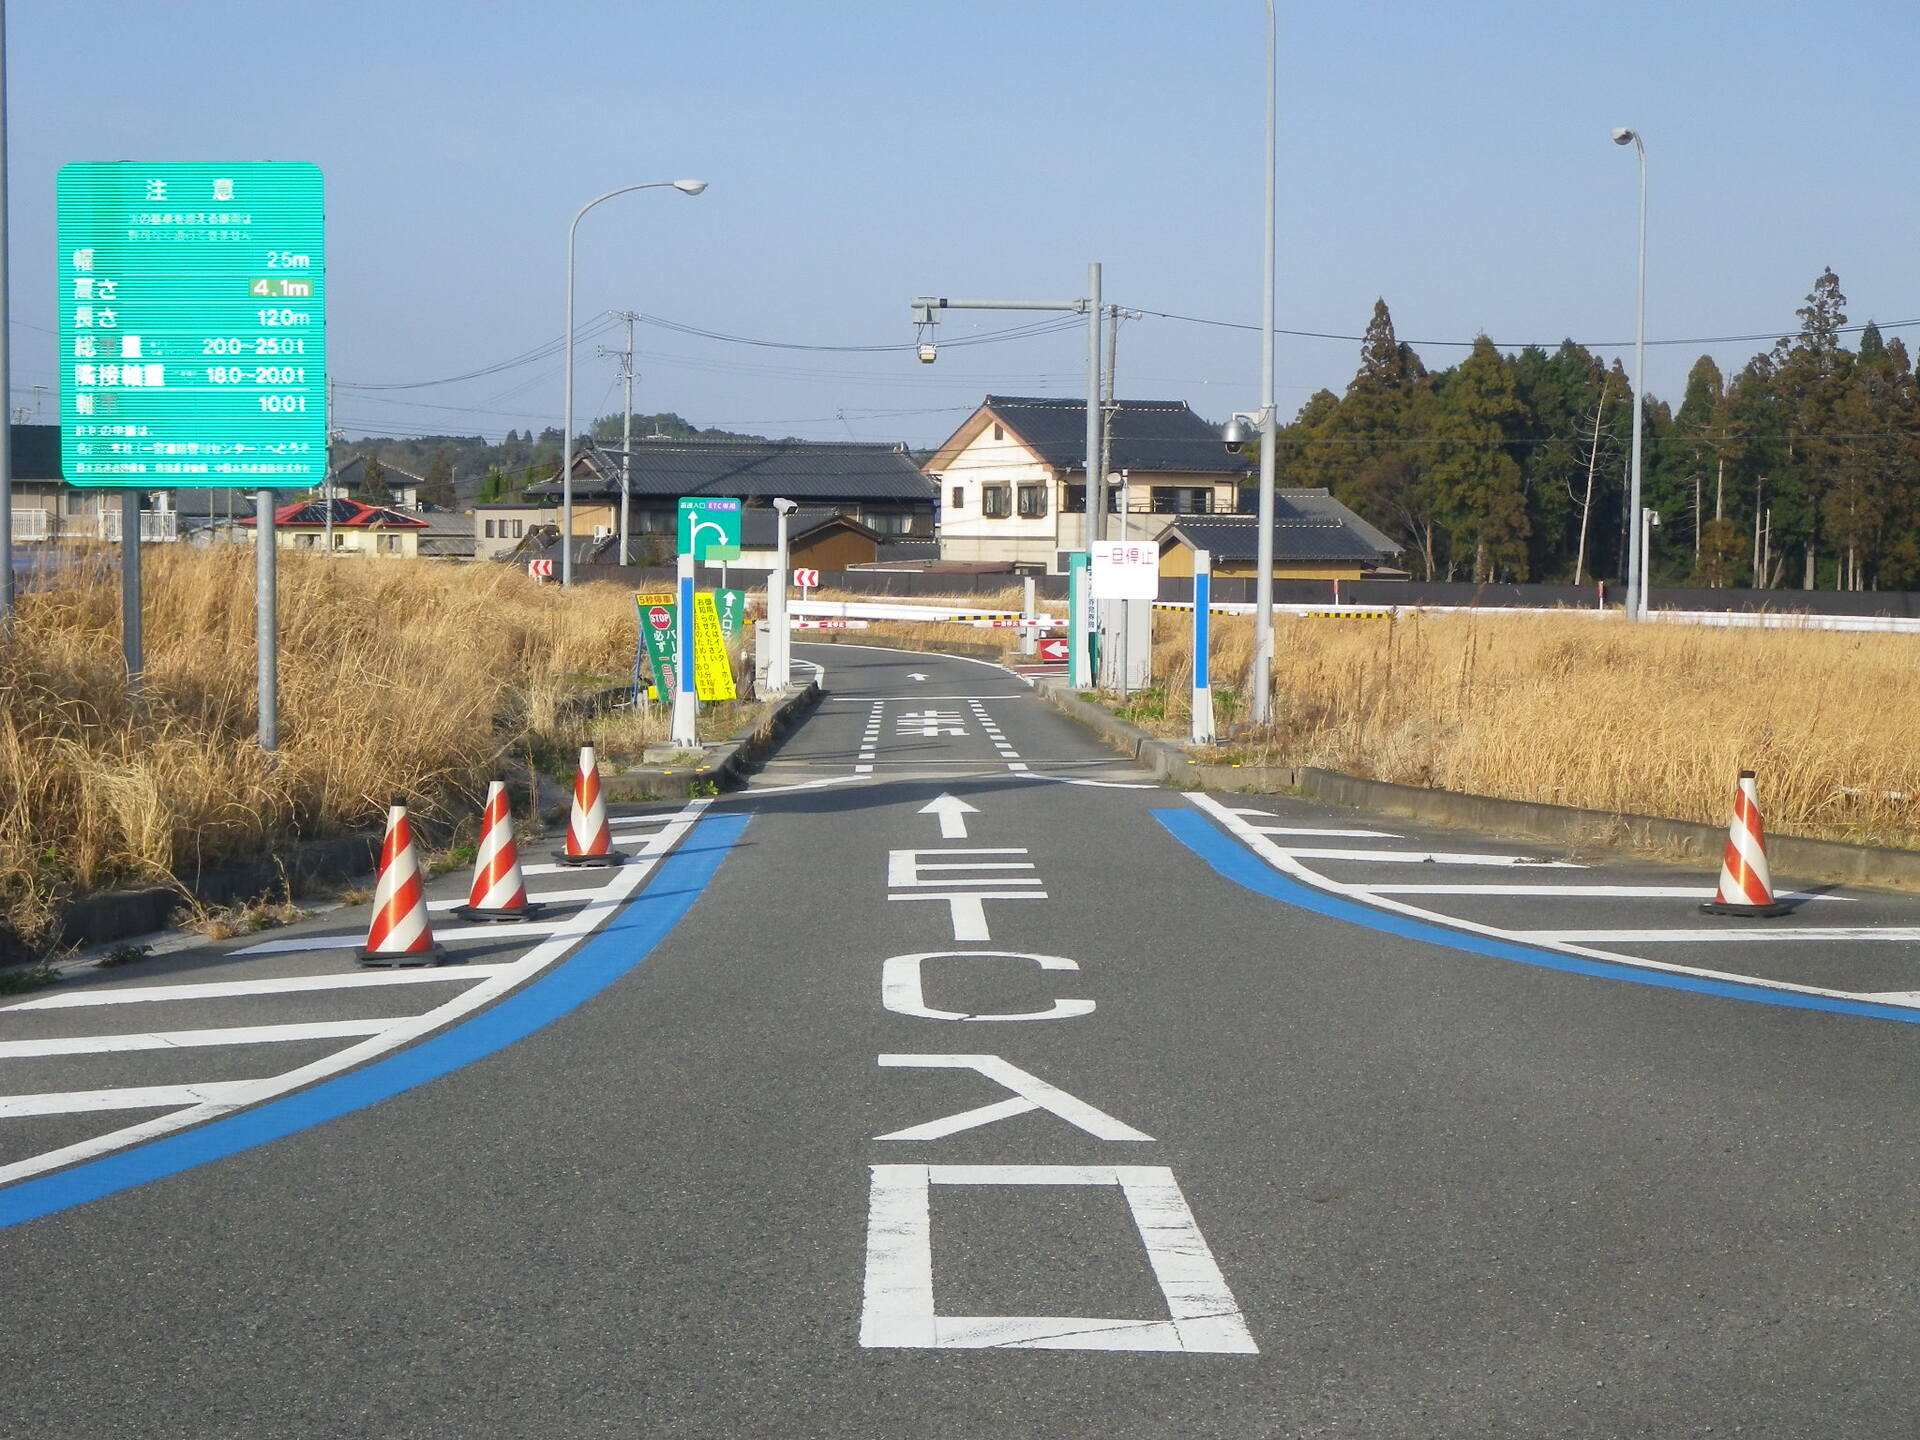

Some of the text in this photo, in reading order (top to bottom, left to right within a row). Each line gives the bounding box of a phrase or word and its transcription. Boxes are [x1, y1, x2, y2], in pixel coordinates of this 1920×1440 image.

[73, 248, 95, 272] 幅
[73, 278, 119, 301] 高さ
[253, 279, 309, 297] 4.1m
[74, 306, 118, 328] 長さ
[649, 613, 671, 623] STOP
